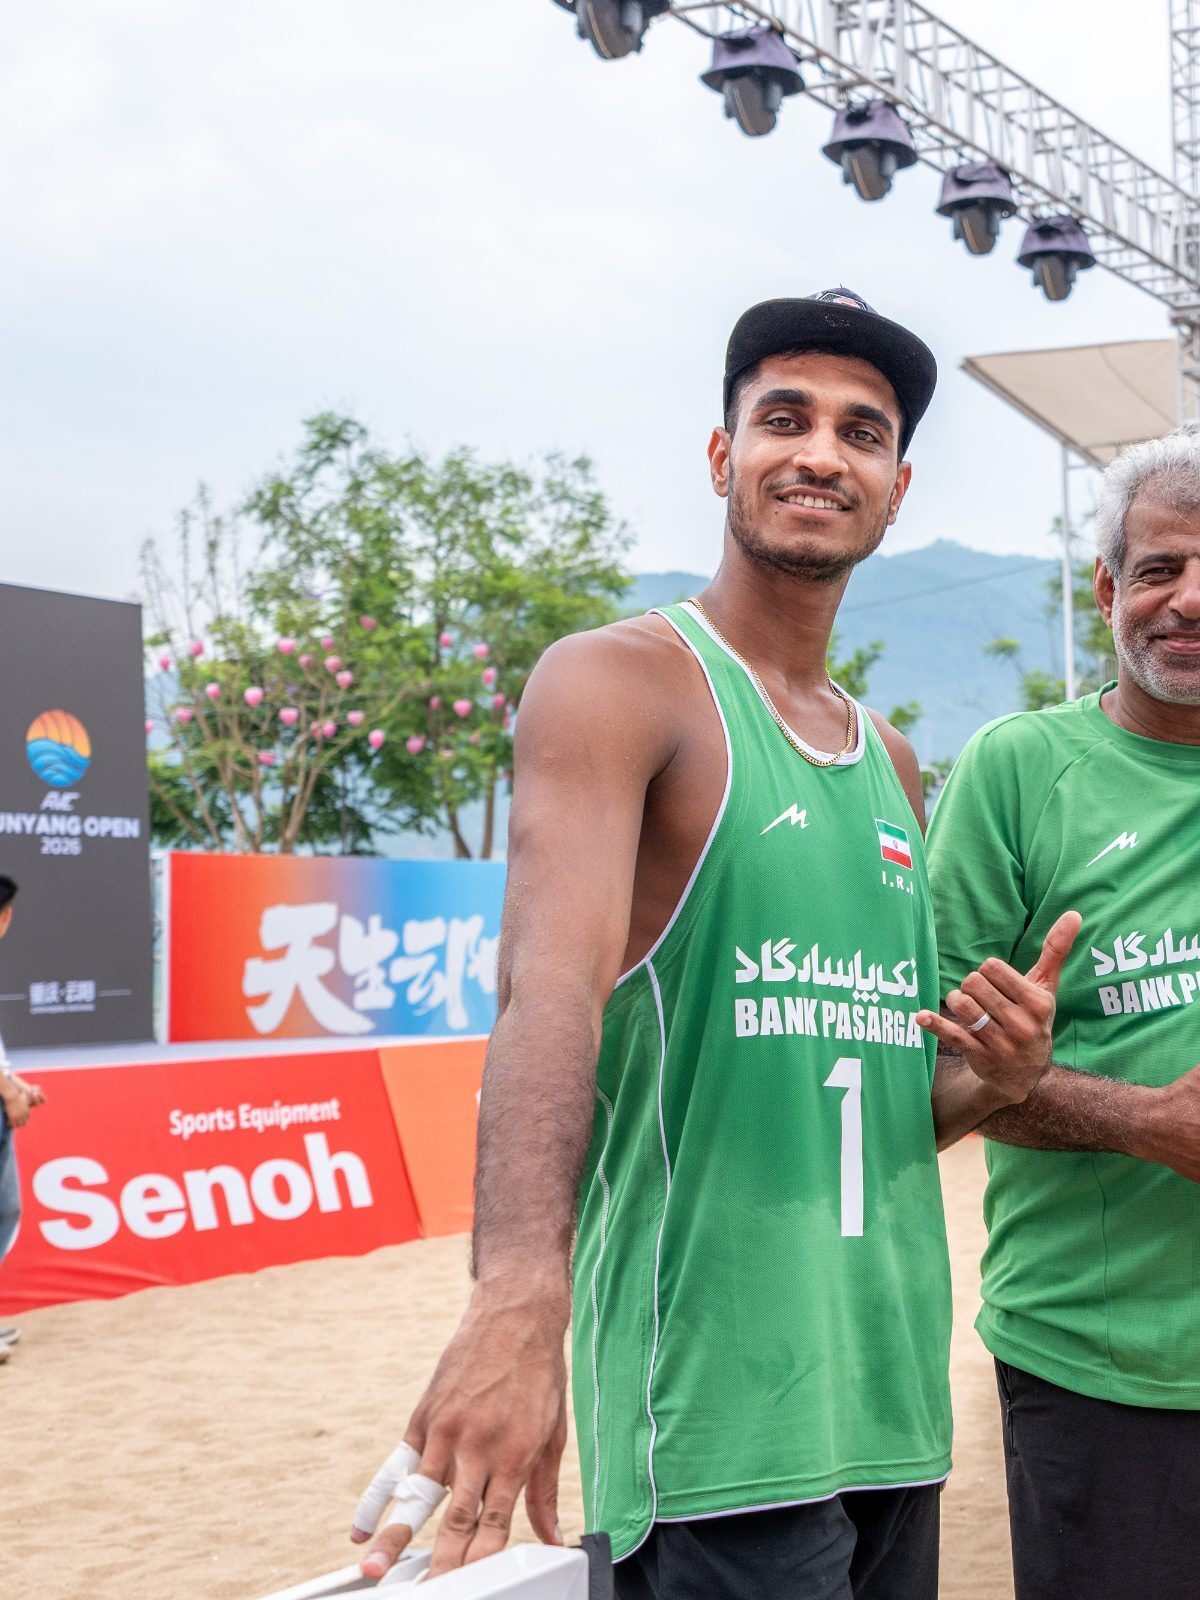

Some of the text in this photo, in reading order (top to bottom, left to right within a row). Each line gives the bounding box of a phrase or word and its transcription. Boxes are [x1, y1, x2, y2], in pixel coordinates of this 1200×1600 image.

[0, 811, 140, 838] NYANG OPEN
[41, 836, 82, 855] 2026
[735, 937, 881, 1004] پاسارگاد
[1098, 975, 1181, 1016] BANK
[735, 997, 925, 1049] BANK PASARGA
[170, 1098, 341, 1140] Sports Equipment
[823, 1057, 864, 1237] 1
[33, 1132, 373, 1250] Senoh
